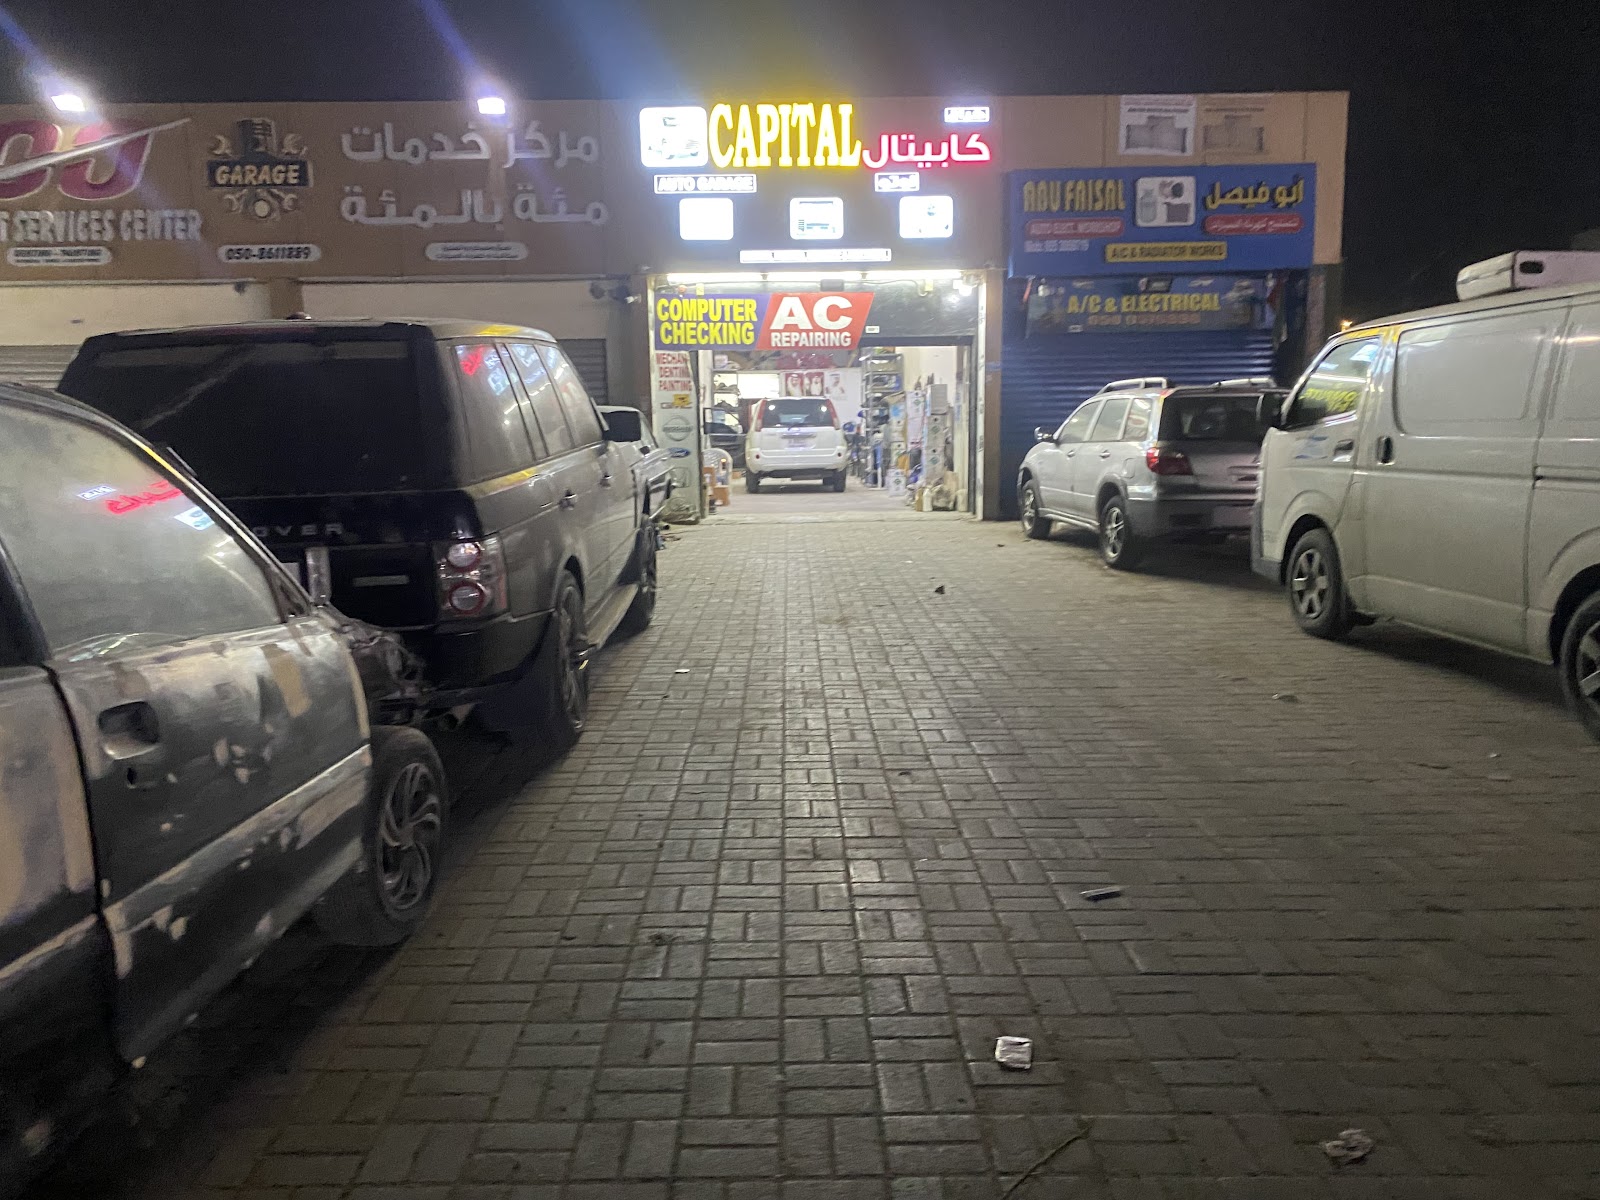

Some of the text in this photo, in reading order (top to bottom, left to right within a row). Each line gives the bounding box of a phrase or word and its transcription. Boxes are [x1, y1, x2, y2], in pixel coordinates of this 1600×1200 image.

[341, 121, 491, 164] خدمات
[709, 103, 861, 168] CAPITAL
[862, 133, 991, 168] كابيتال
[215, 164, 300, 185] GARAGE
[657, 176, 754, 192] AUTO GARAGE
[1064, 179, 1126, 212] FAISAL
[1205, 181, 1271, 210] فيصل
[13, 210, 115, 242] SERVICES
[119, 210, 203, 241] CENTER
[656, 298, 757, 321] COMPUTER
[769, 296, 853, 330] AC
[1067, 293, 1221, 314] A/C & ELECTRICAL
[659, 322, 755, 345] CHECKING
[770, 332, 851, 347] REPAIRING
[251, 523, 343, 538] OVER
